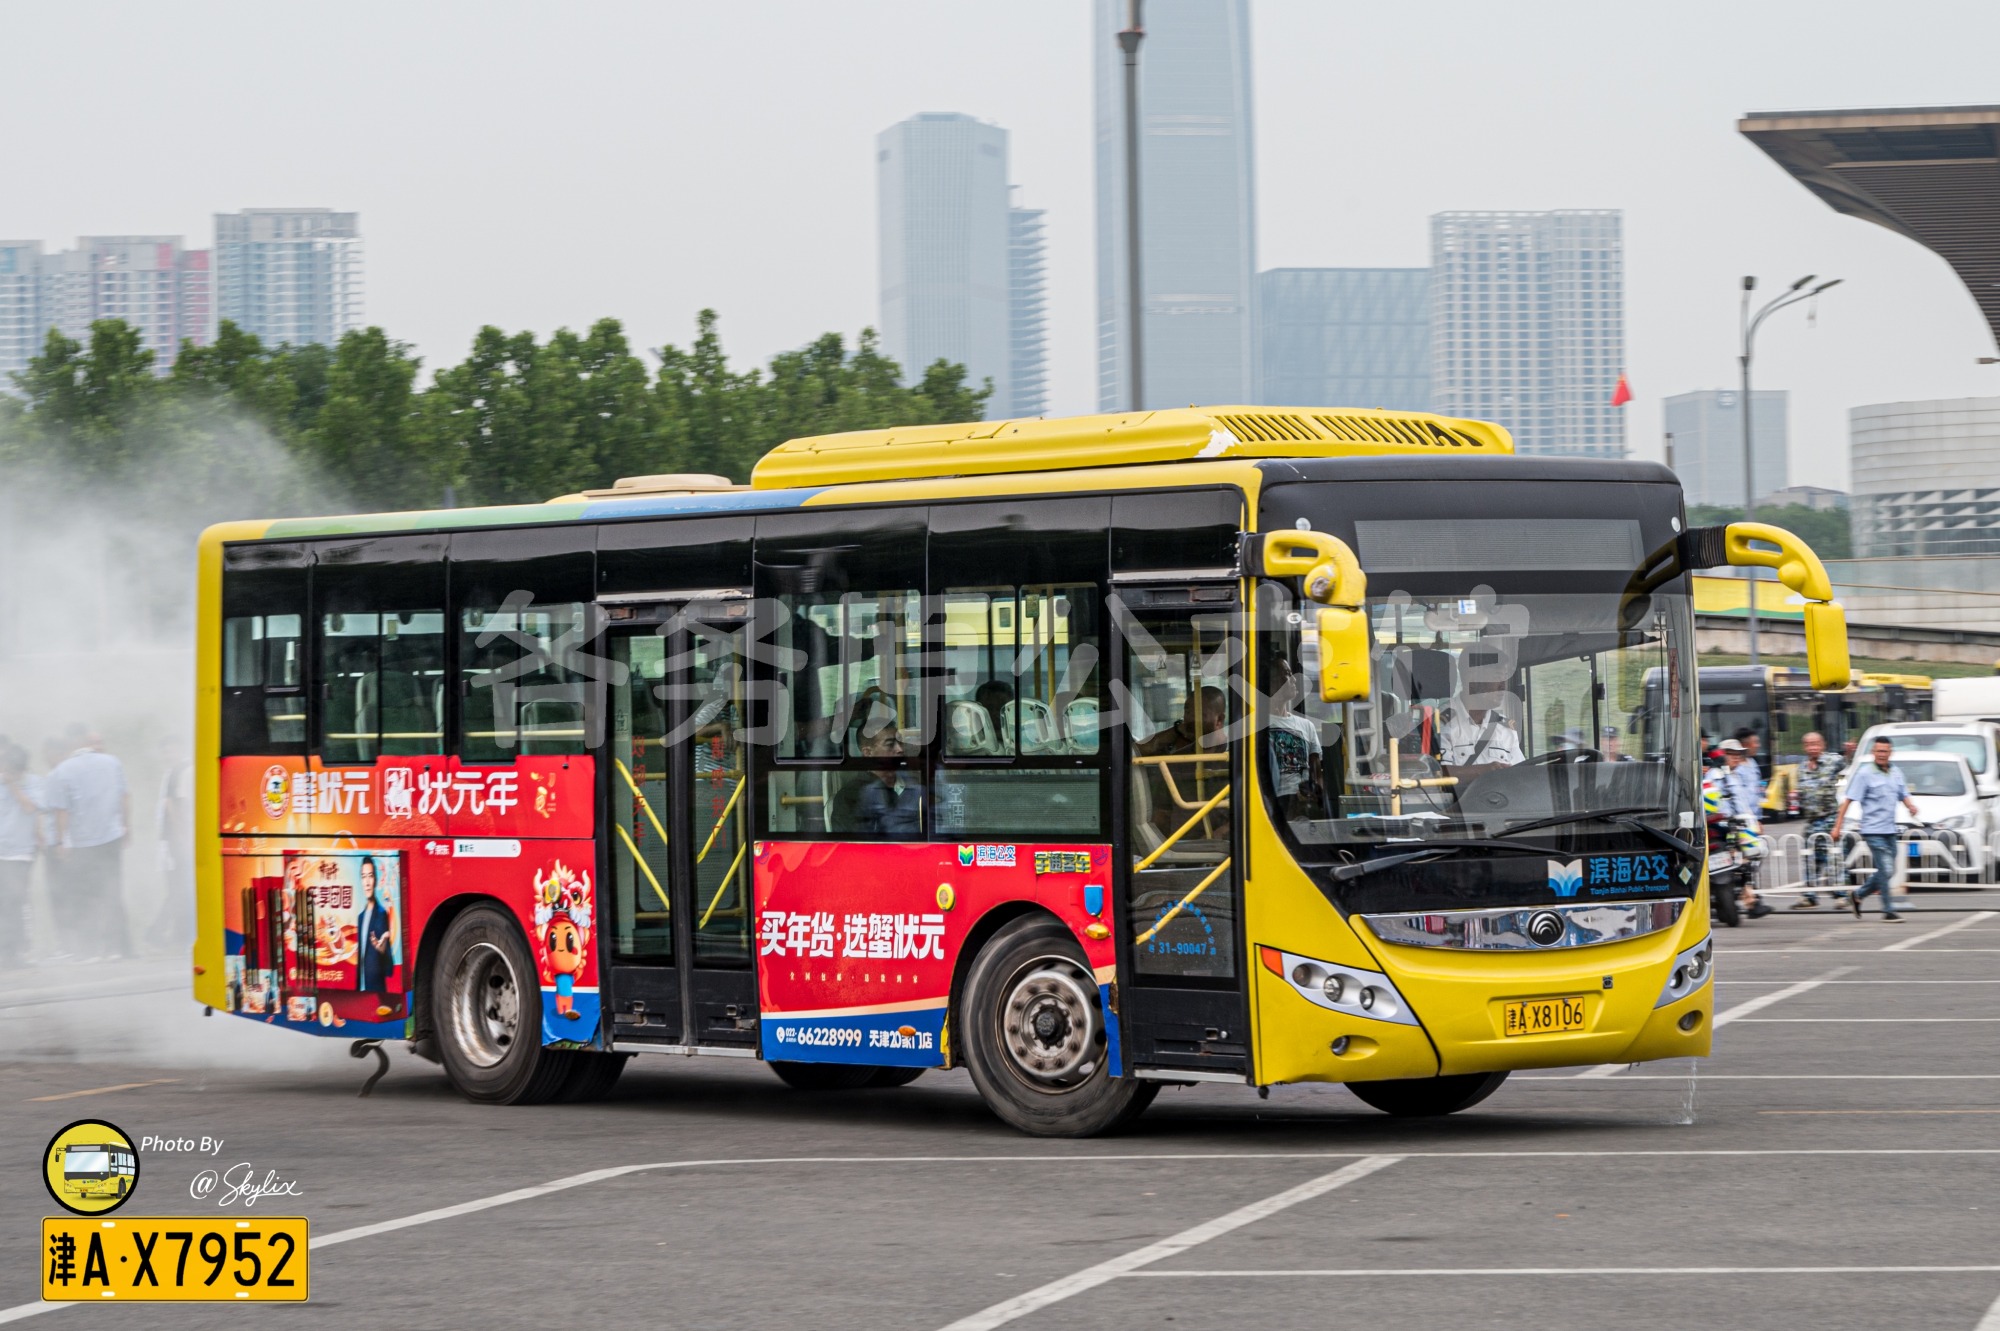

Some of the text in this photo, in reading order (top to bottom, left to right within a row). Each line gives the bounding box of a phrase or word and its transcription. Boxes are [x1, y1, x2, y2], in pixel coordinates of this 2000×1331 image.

[1589, 854, 1670, 885] 滨海公交
[1589, 884, 1670, 896] Tianjin Binhai Public Transport
[1158, 941, 1207, 955] 31-90047
[797, 1027, 863, 1047] 66228999
